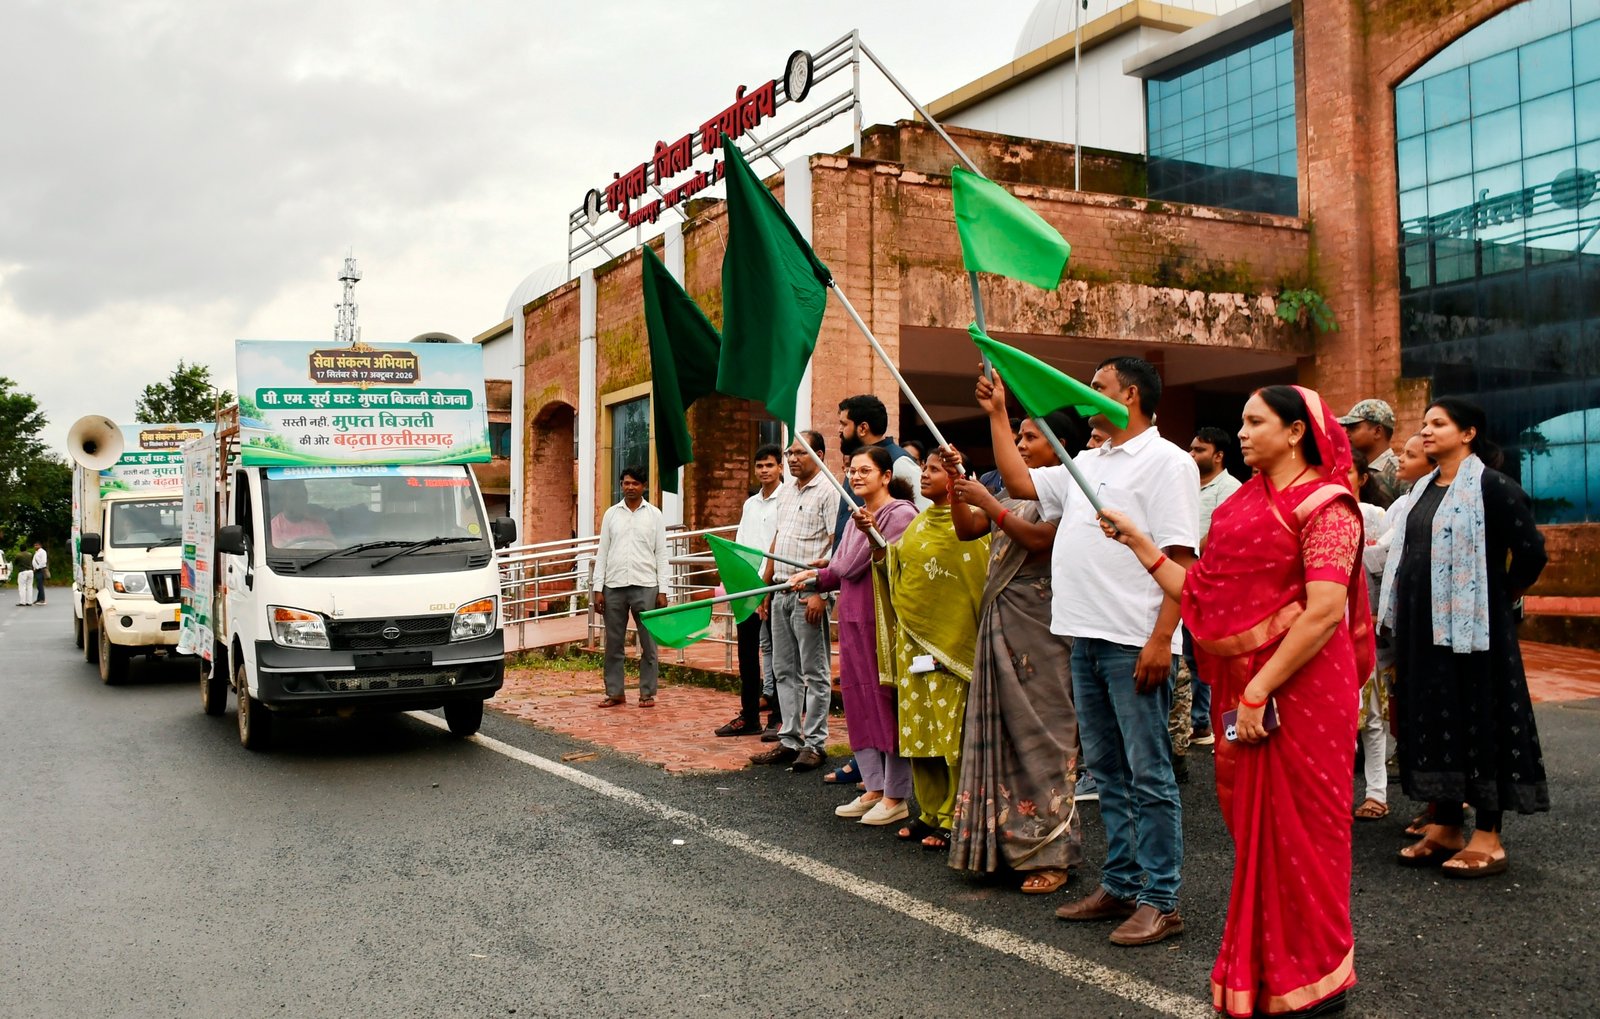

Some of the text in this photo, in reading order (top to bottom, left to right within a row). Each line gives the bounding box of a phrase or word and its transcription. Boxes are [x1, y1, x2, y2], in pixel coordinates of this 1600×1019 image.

[604, 80, 776, 220] संयुक्त जिला कार्यालय
[313, 353, 415, 369] सेवा संकल्प अभियान
[326, 369, 350, 378] सितंबर
[351, 369, 358, 378] से
[370, 371, 394, 381] अक्टूबर
[262, 391, 280, 405] पी.
[283, 394, 306, 405] एम.
[308, 390, 331, 407] सूर्य
[358, 393, 388, 408] मुफ्त
[390, 391, 429, 405] बिजली
[431, 392, 467, 406] योजना
[282, 416, 307, 427] सस्ती
[331, 415, 374, 432] मुफ्त
[379, 412, 434, 428] बिजली
[141, 431, 154, 441] सेवा
[299, 430, 453, 449] की ओर बढ़ता छत्तीसगढ़
[139, 453, 152, 464] सूर्य
[152, 466, 177, 477] मुफ्त
[283, 466, 332, 476] SHIVAM
[153, 477, 181, 487] बढ़ता
[429, 603, 456, 611] GOLD
